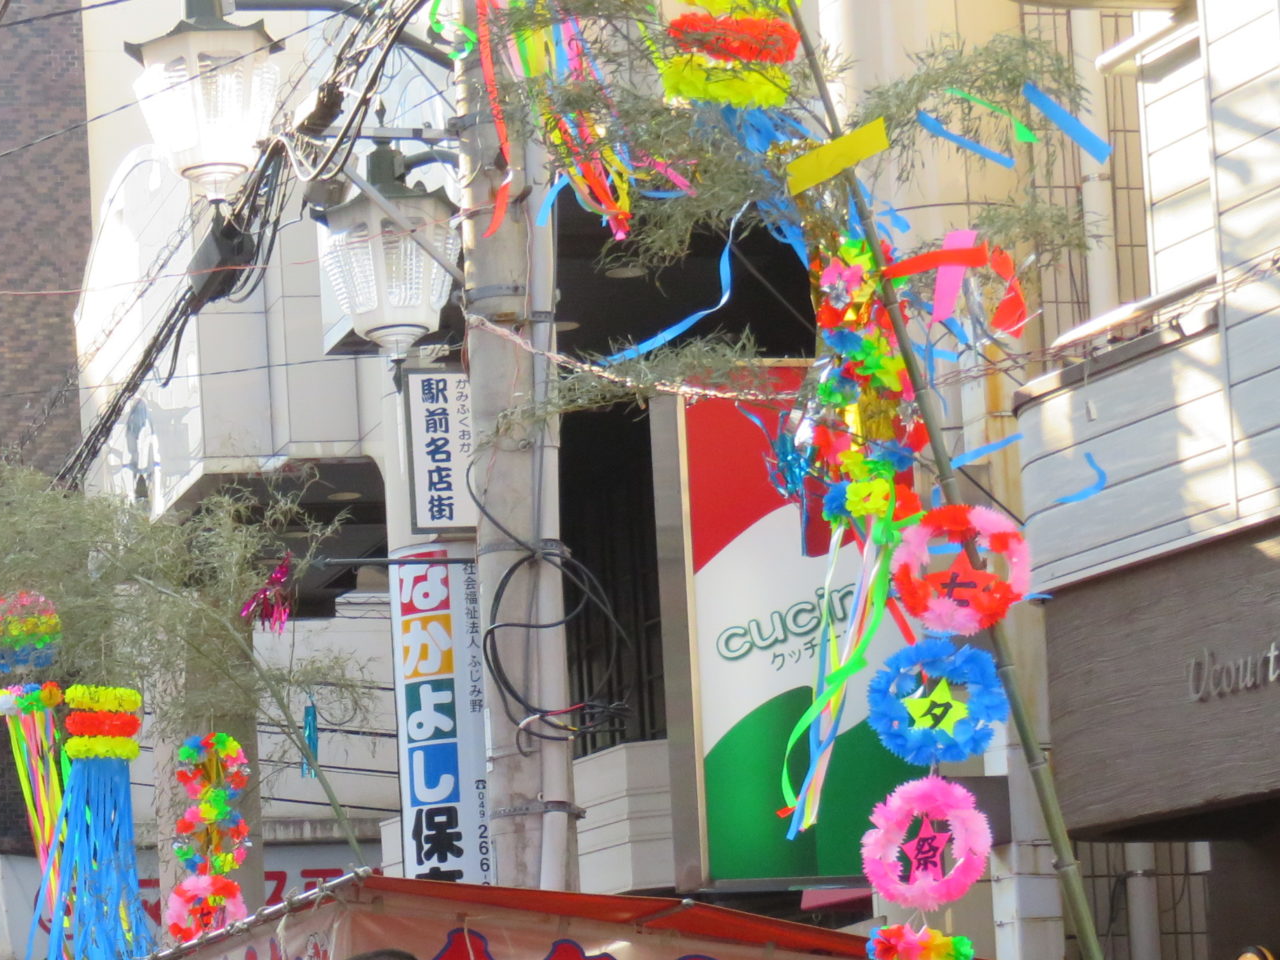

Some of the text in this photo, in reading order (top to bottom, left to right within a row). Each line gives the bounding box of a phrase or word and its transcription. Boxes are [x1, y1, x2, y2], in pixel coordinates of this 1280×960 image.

[420, 377, 454, 522] 駅前名店街
[462, 563, 483, 713] 社会福祉法人 ふじみ野
[920, 701, 953, 729] 夕
[477, 791, 491, 886] 049-266-
[915, 835, 939, 872] 祭
